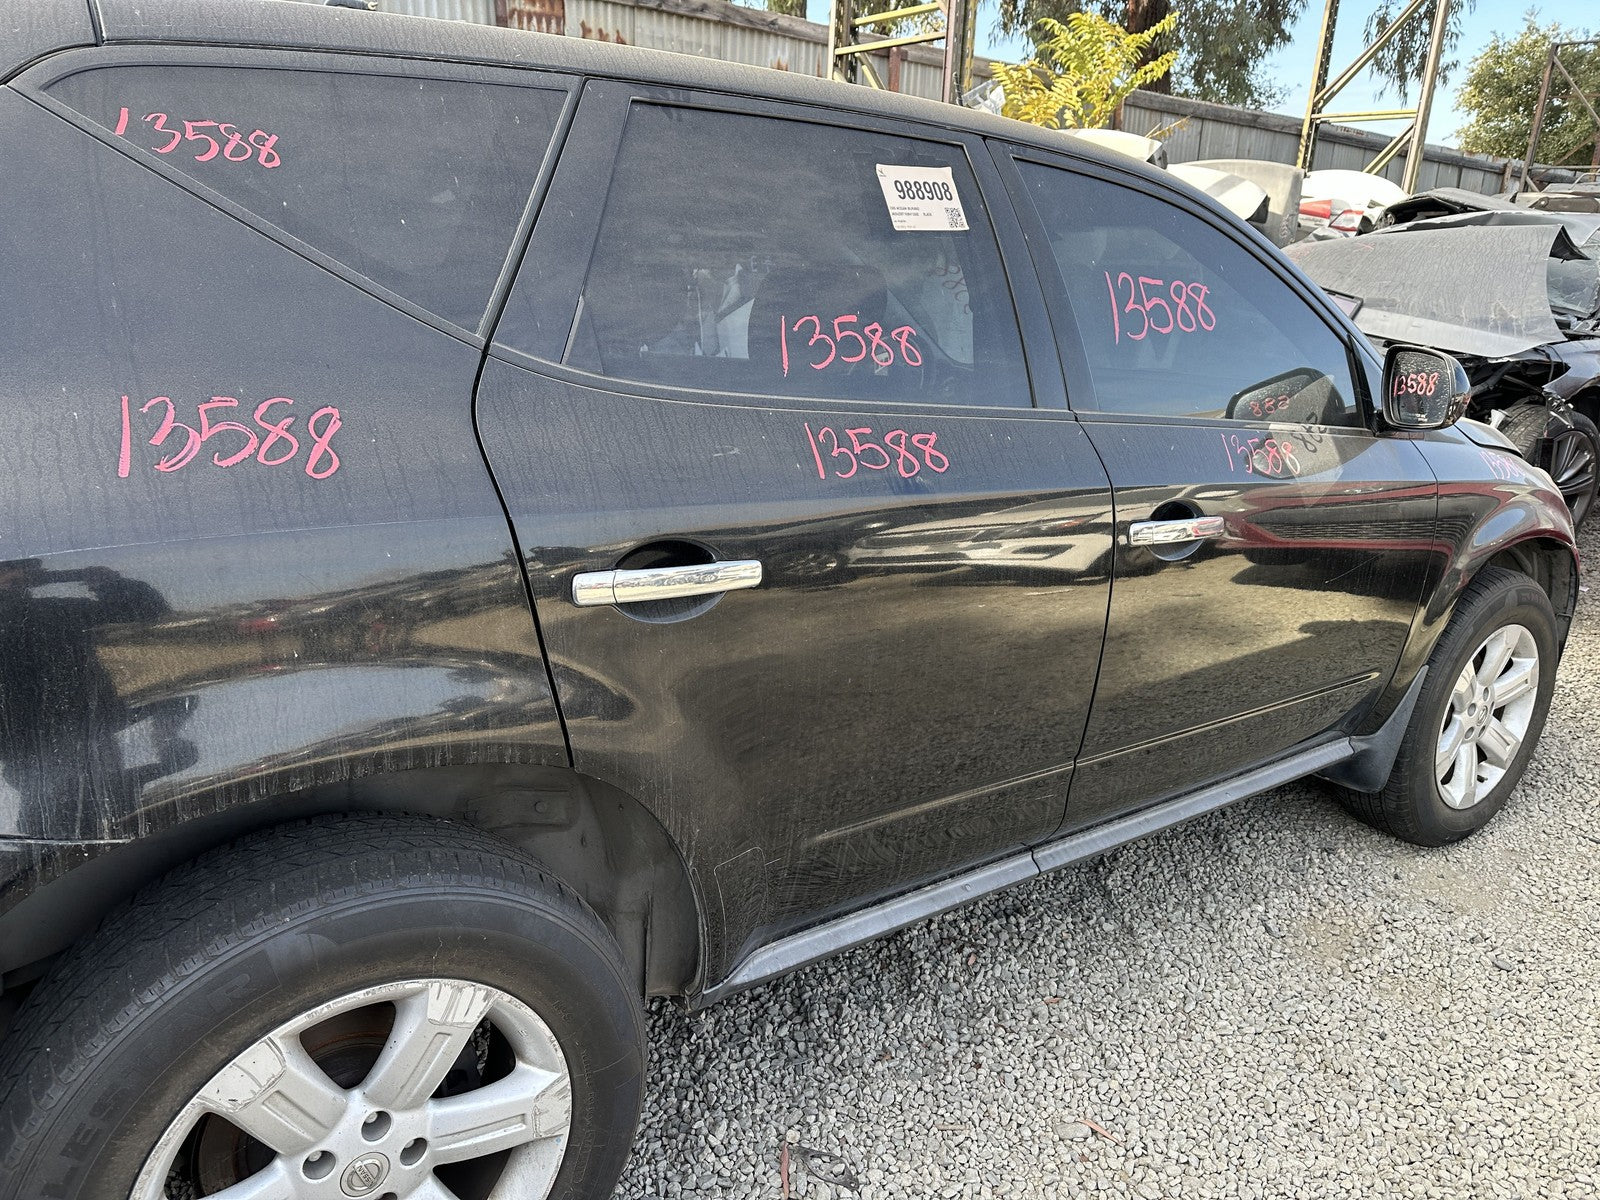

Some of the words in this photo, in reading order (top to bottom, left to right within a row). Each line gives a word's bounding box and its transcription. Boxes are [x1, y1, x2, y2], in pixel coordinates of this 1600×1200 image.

[115, 107, 281, 168] 13588
[894, 179, 953, 201] 988908
[1105, 271, 1217, 345] 13588
[781, 314, 923, 377] 13588
[1393, 372, 1439, 397] 13588
[118, 395, 342, 479] 13588
[804, 423, 949, 480] 13588
[1221, 433, 1301, 475] 13588
